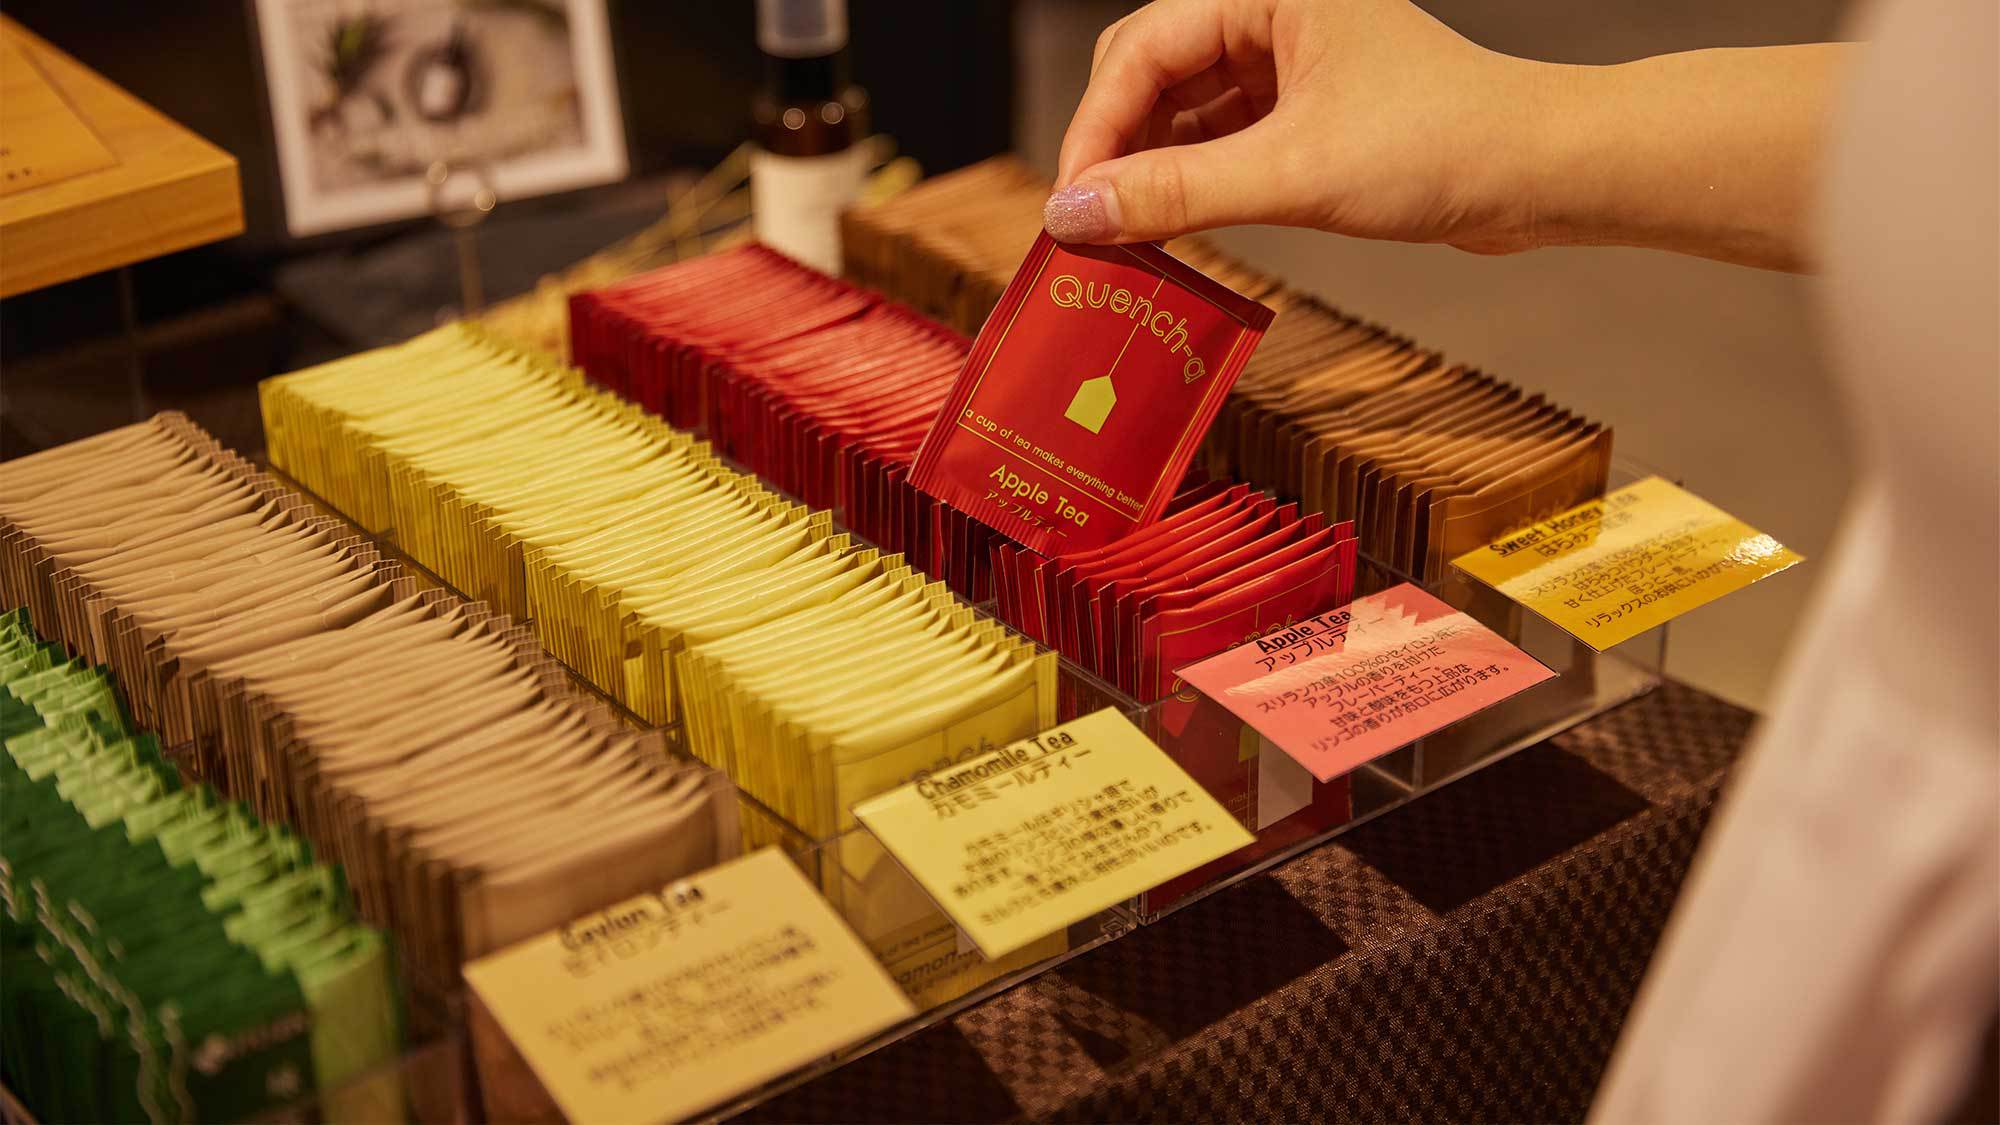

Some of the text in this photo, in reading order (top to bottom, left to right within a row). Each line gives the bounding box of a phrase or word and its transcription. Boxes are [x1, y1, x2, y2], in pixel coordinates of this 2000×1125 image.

[1050, 275, 1205, 384] Quench-a
[965, 407, 1145, 513] a cup of tea makes everything better
[984, 489, 1068, 538] アップルティー
[989, 464, 1090, 527] Apple Tea
[1489, 528, 1546, 556] Sweet
[1544, 506, 1603, 533] Honey
[1255, 617, 1385, 672] アップルティー
[1256, 609, 1351, 653] Apple Tea
[1329, 663, 1439, 710] フレーバーティー。
[916, 747, 1028, 801] Chamomile
[1029, 730, 1075, 755] Tea
[931, 748, 1092, 821] カモミールティー
